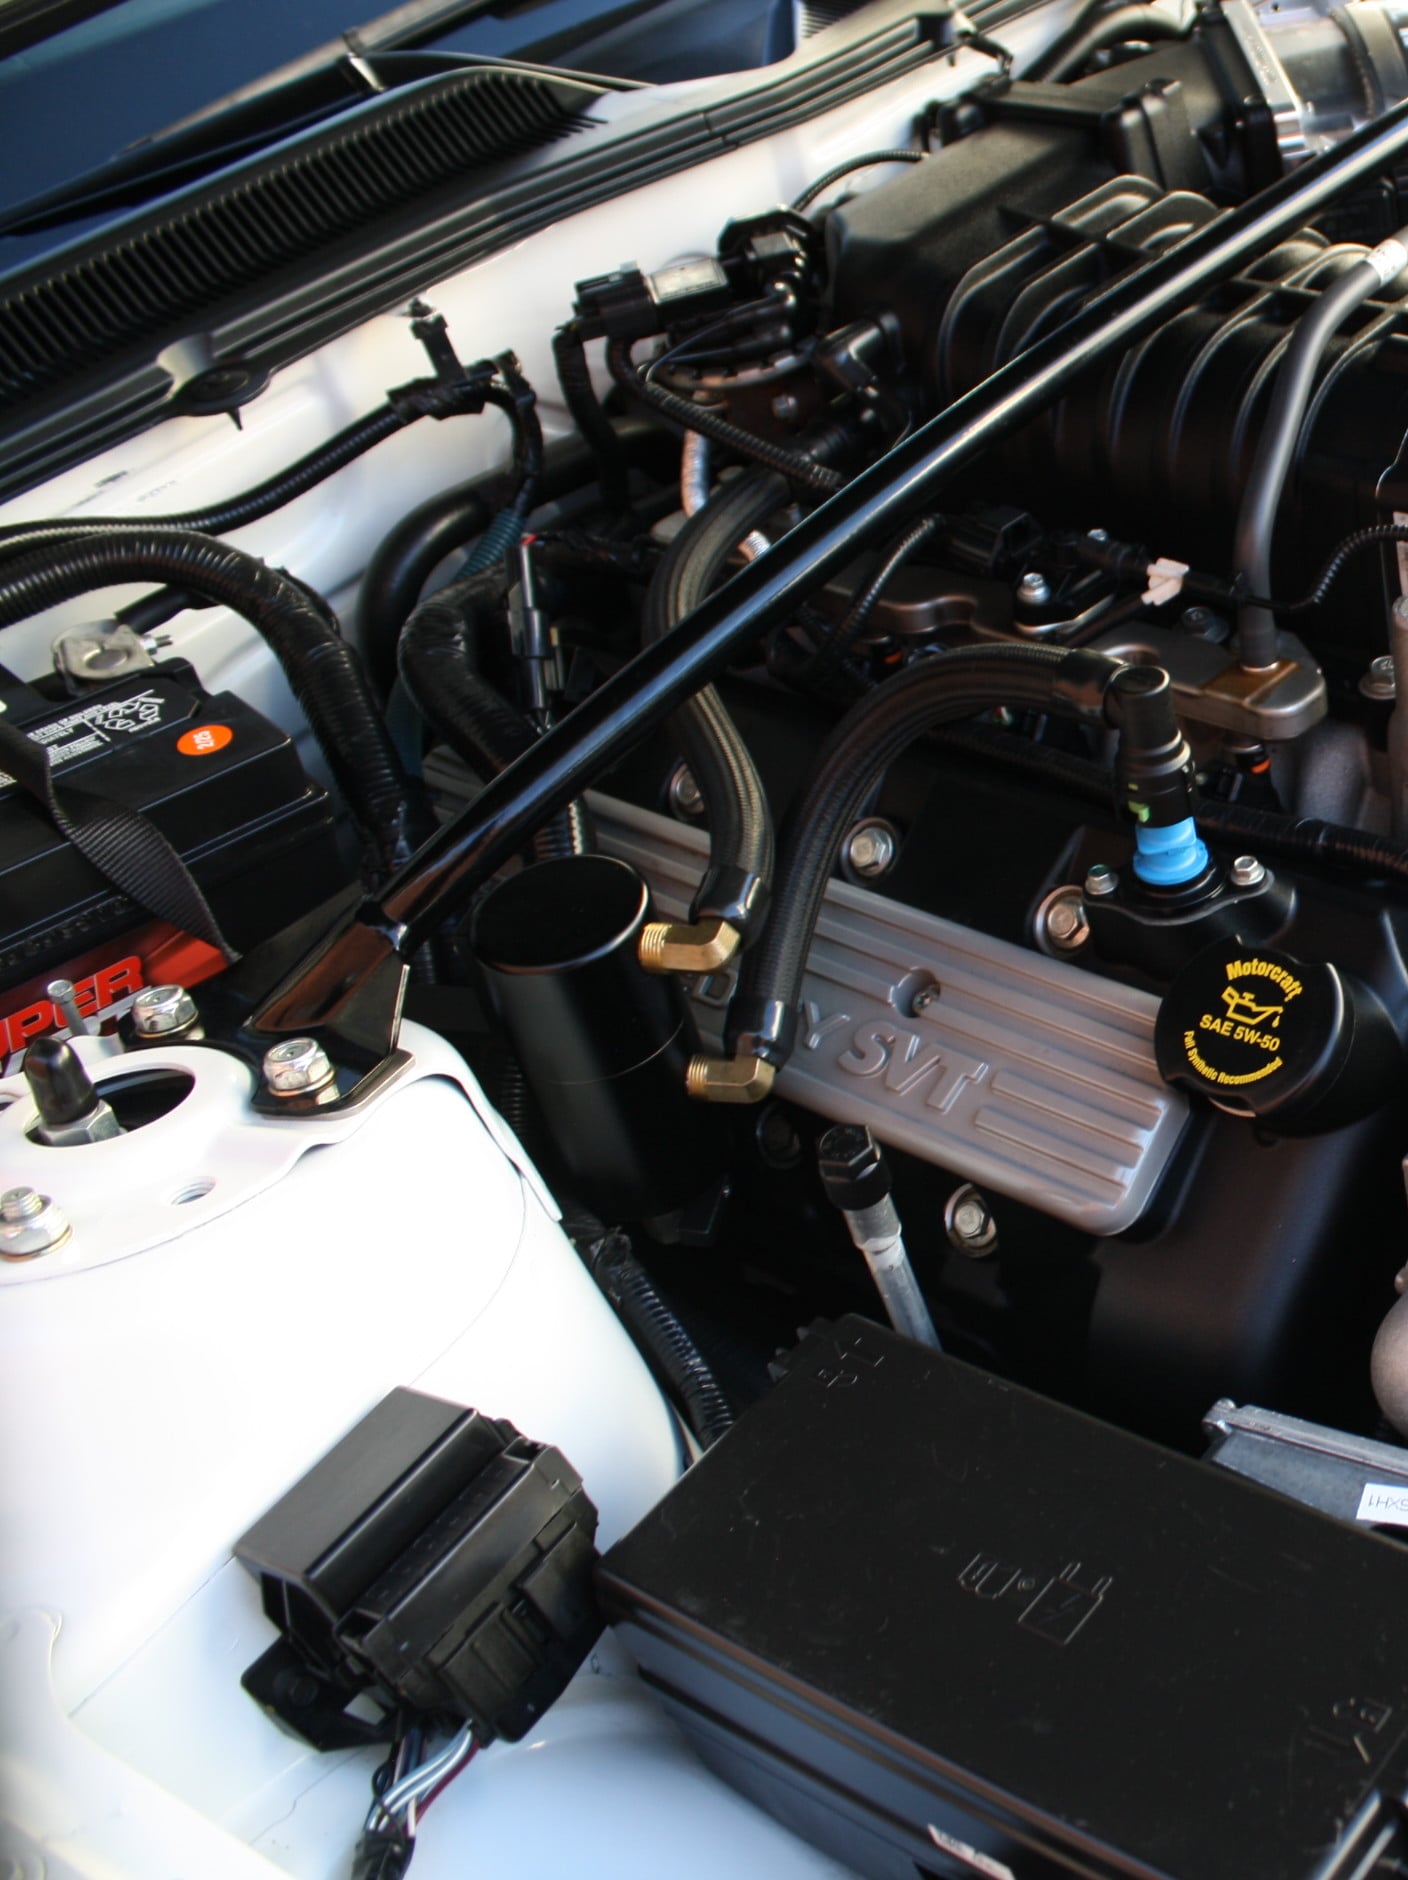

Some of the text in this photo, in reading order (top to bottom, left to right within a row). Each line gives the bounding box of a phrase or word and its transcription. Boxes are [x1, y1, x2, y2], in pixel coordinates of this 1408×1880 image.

[1226, 957, 1304, 1003] Motorcraft
[0, 955, 145, 1061] PER
[1183, 1029, 1197, 1050] Full
[1199, 1013, 1282, 1052] SAE 5W-50
[838, 1019, 990, 1116] SVT
[1186, 1046, 1219, 1082] Synthetic
